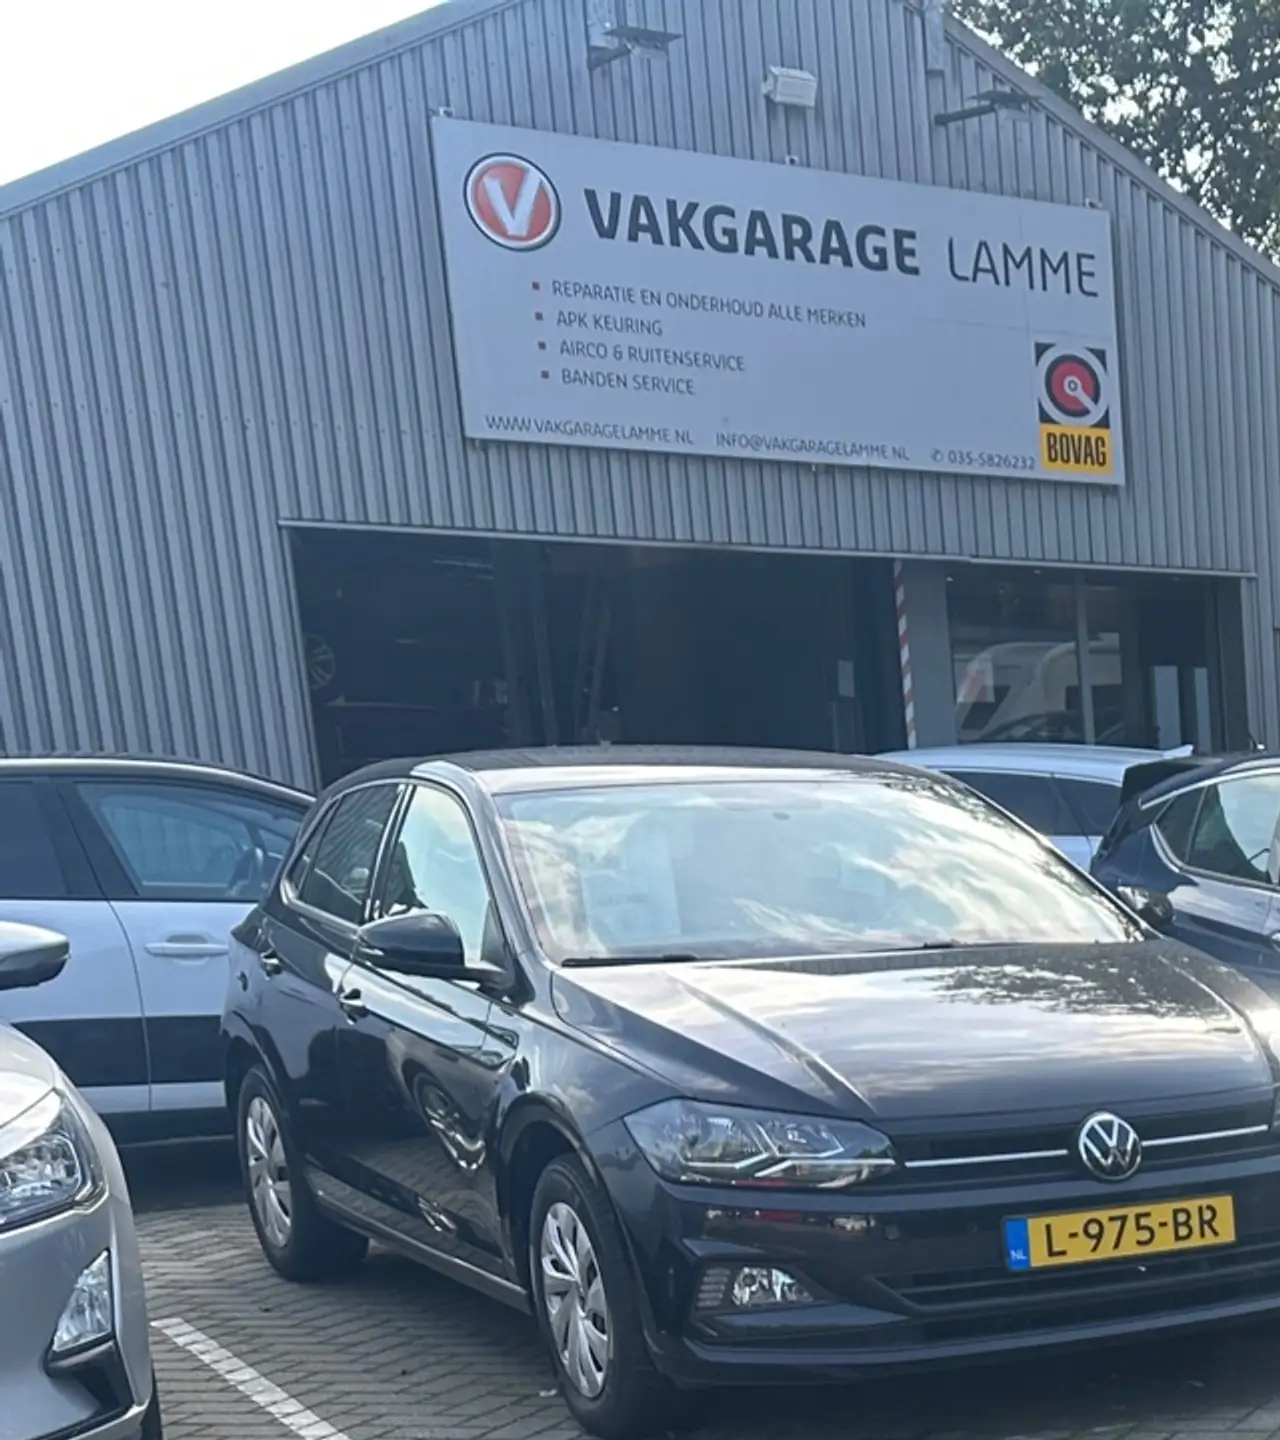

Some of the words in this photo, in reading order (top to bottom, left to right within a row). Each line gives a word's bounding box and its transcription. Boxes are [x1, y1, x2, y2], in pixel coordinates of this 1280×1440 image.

[583, 187, 921, 277] VAKGARAGE
[946, 236, 1100, 298] LAMME
[552, 280, 635, 304] REPARATIE
[640, 288, 663, 307] EN
[666, 292, 764, 319] ONDERHOUD
[767, 304, 805, 323] ALLE
[806, 308, 867, 328] MERKEN
[556, 310, 589, 330] APK
[592, 312, 664, 337] KEURING
[559, 339, 608, 361] AIRCO
[611, 344, 625, 362] &
[627, 345, 746, 373] RUITENSERVICE
[560, 368, 629, 390] BANDEN
[632, 374, 697, 396] SERVICE
[485, 414, 695, 446] WWW.VAKGARAGELAMME.NL
[715, 432, 911, 463] INFO@VAKGARAGELAMME.NL
[947, 449, 1036, 471] 035-5826232
[1046, 432, 1107, 468] BOVAG
[1010, 1248, 1028, 1262] NL
[1044, 1203, 1220, 1259] L-975-BR
